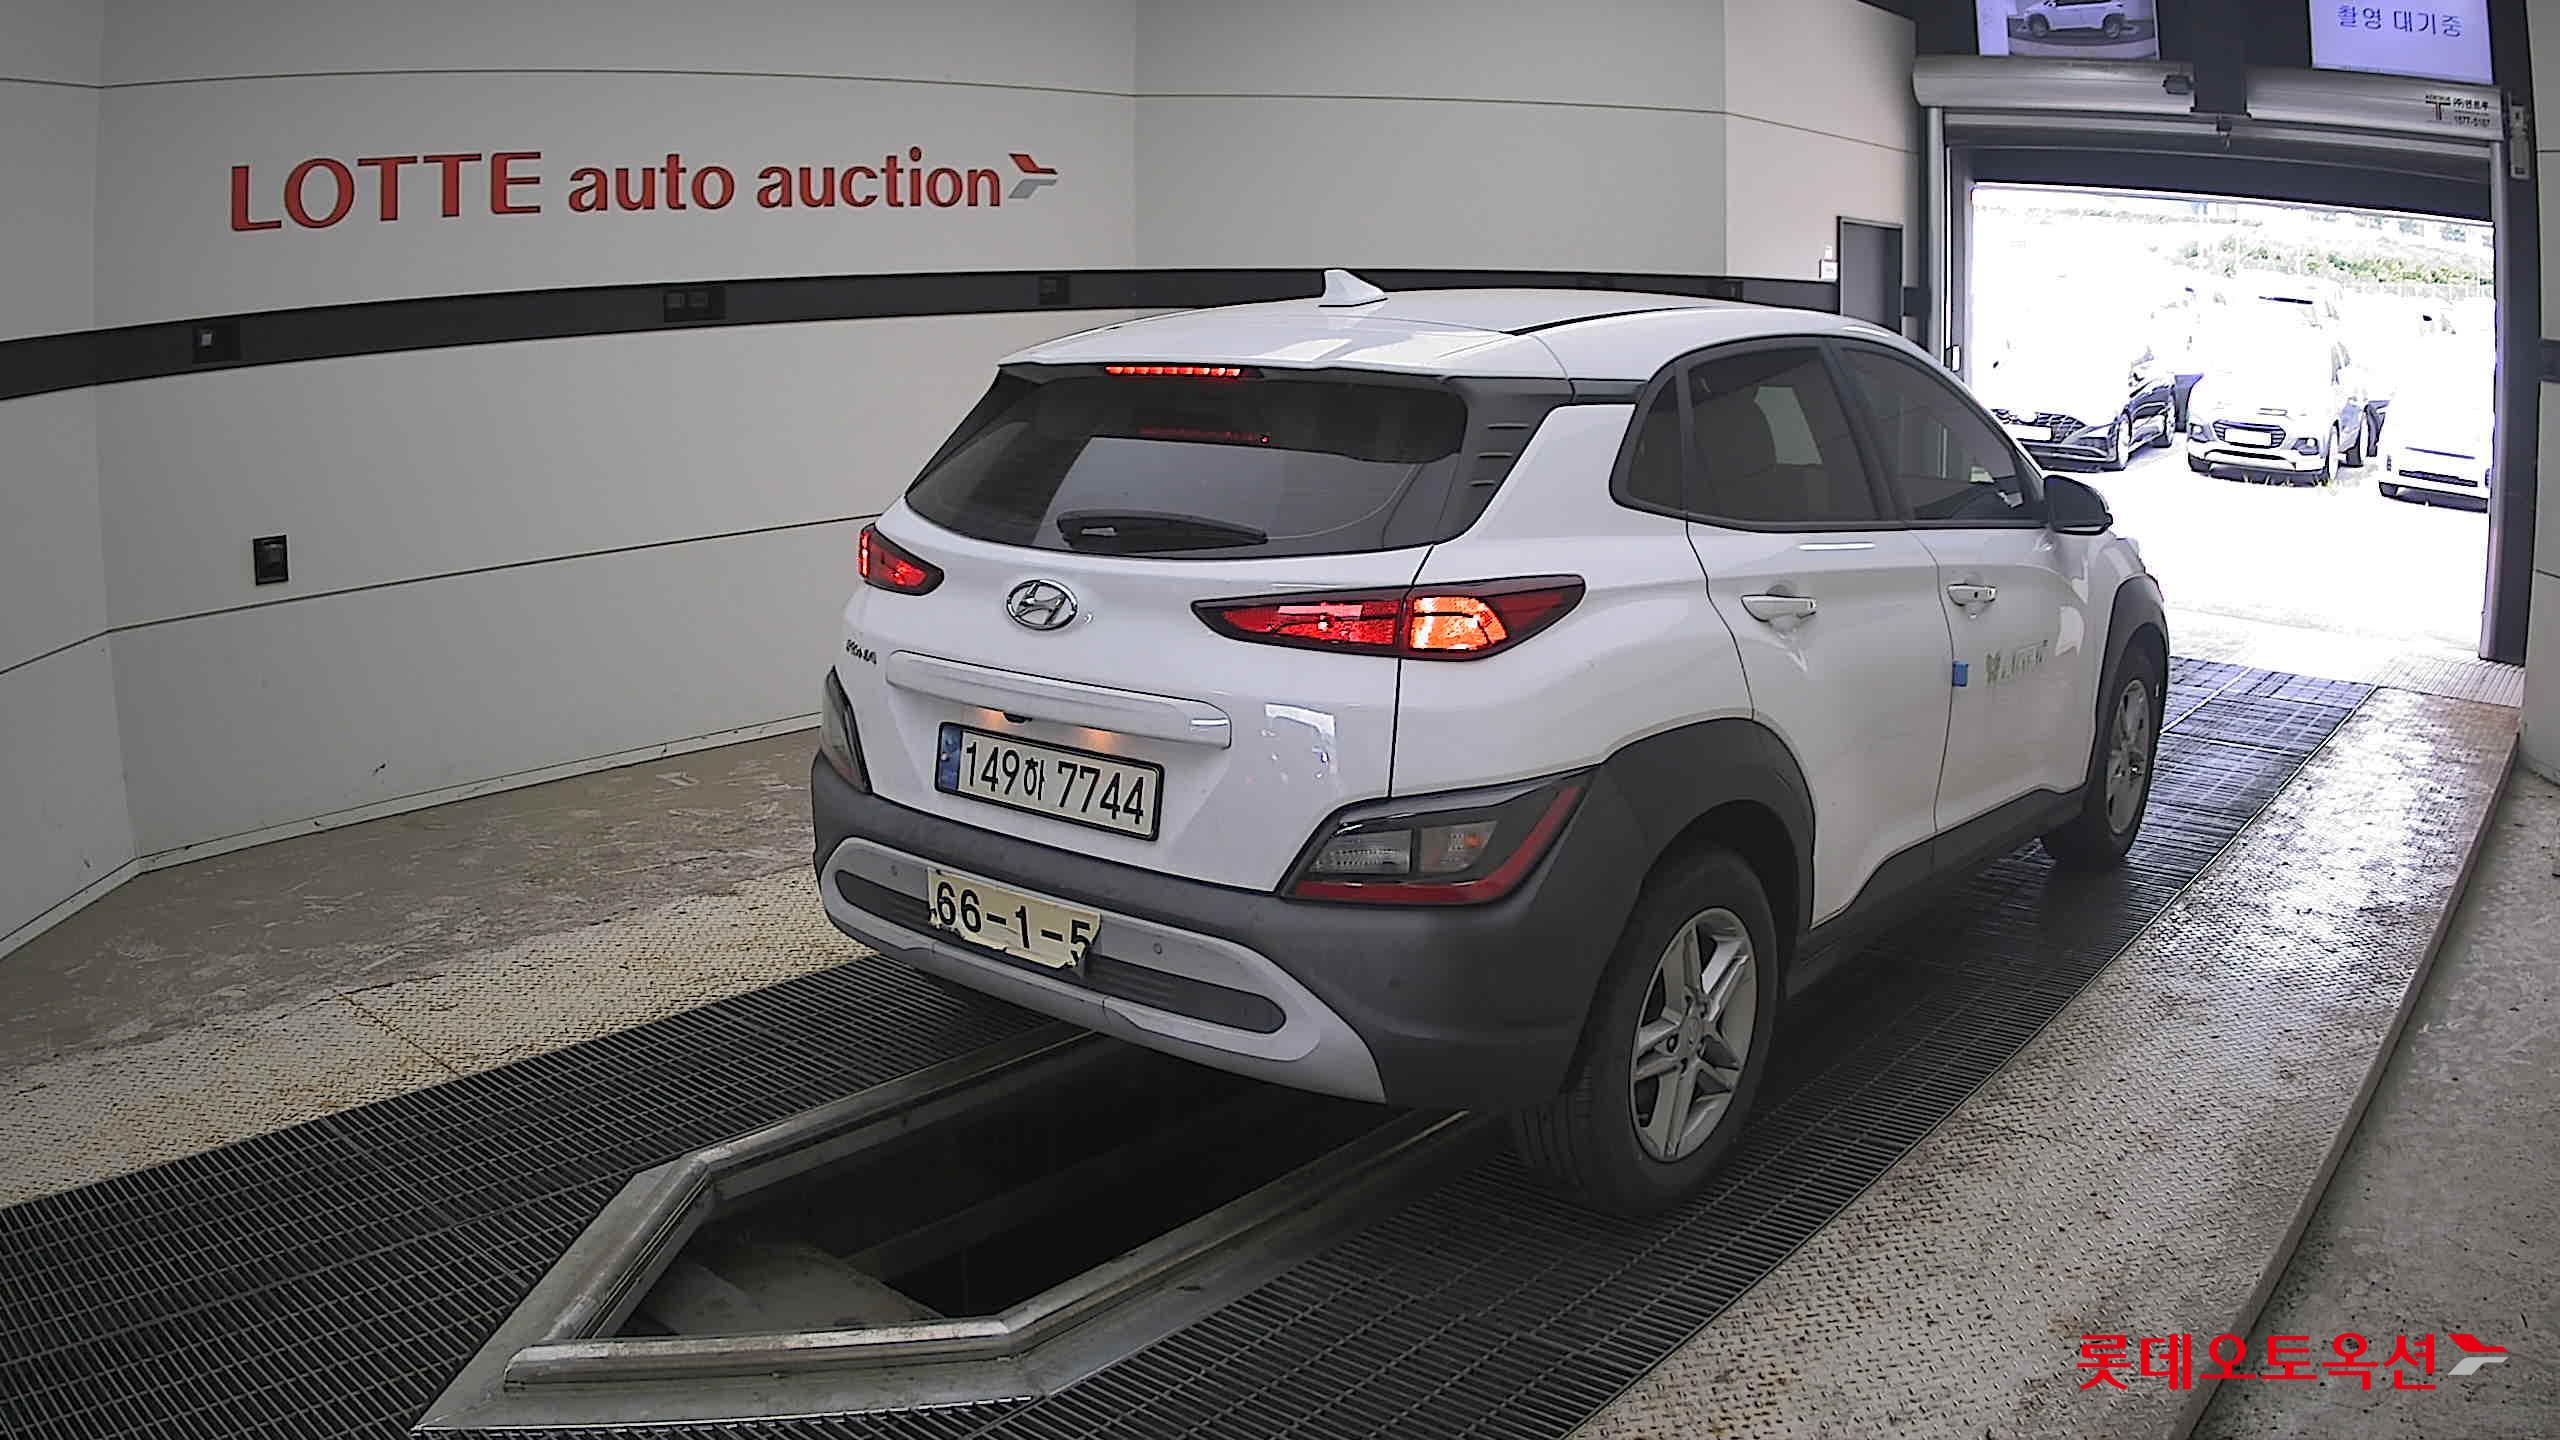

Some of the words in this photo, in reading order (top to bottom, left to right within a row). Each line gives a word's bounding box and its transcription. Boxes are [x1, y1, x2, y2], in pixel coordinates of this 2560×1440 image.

[2337, 4, 2383, 31] 촬영
[2392, 9, 2462, 38] 대기중
[230, 150, 542, 231] LOTTE
[567, 152, 735, 211] auto
[756, 145, 1003, 211] auction
[965, 740, 1046, 801] 149하
[1056, 759, 1145, 825] 7744
[936, 880, 1093, 968] 66-1-5
